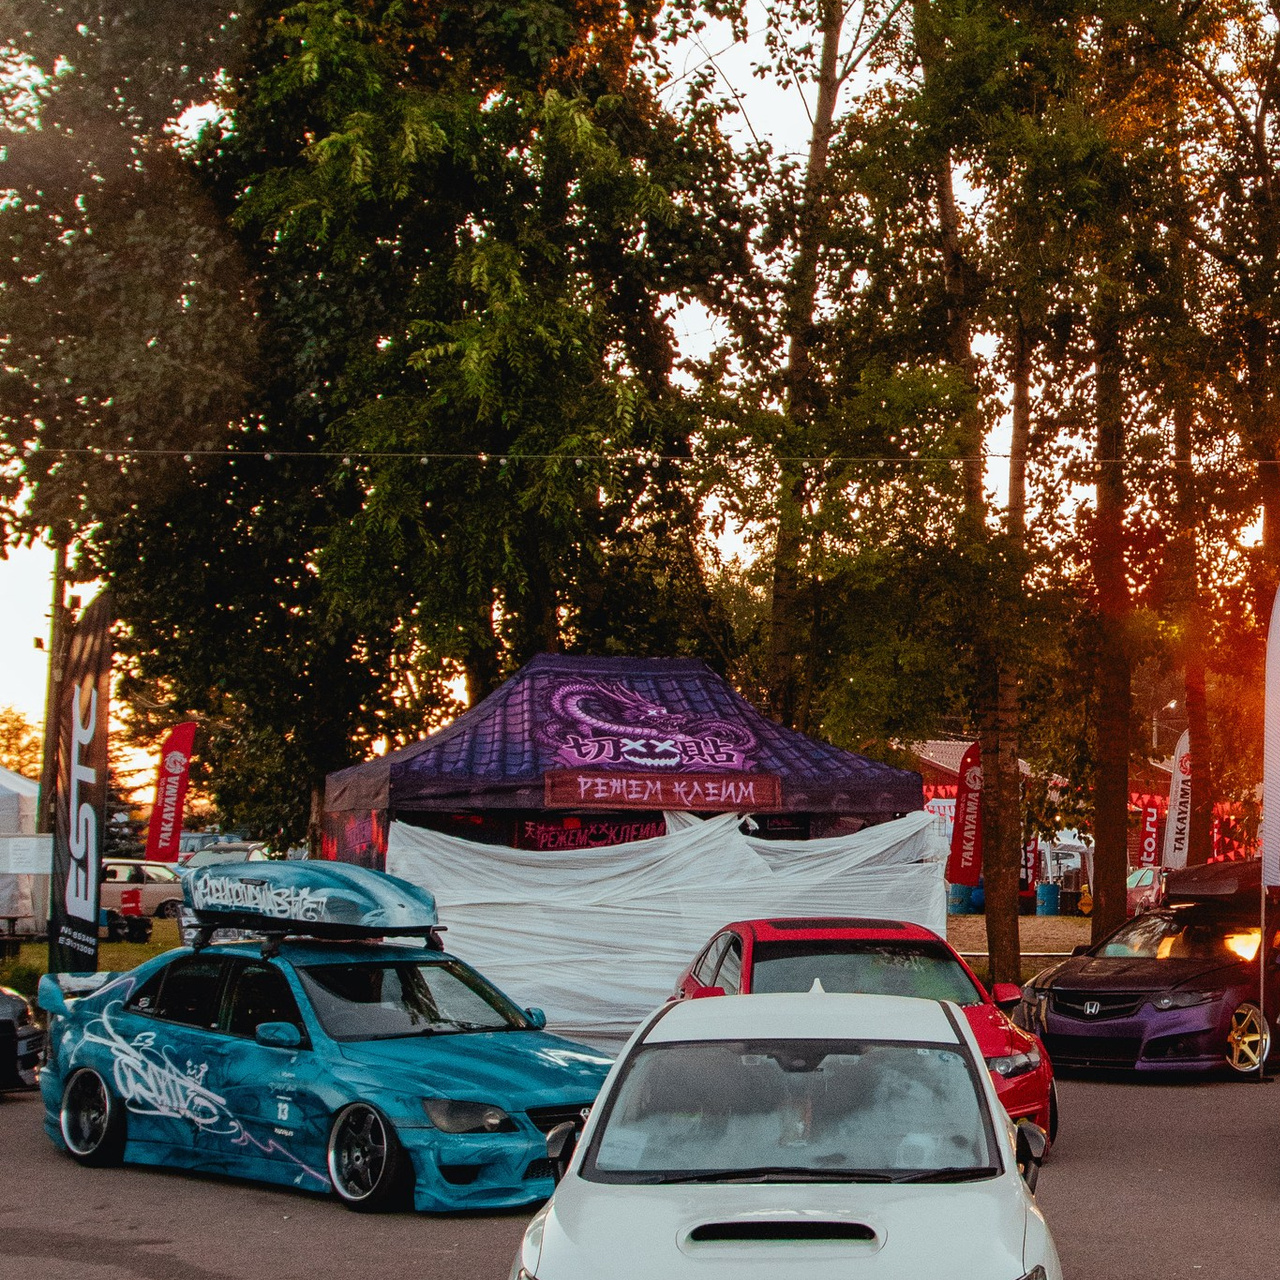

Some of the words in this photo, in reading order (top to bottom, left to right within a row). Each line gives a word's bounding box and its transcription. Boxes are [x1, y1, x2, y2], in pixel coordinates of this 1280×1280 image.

[65, 683, 97, 922] ESTC
[158, 775, 180, 849] TAKAYAMA
[576, 775, 663, 802] РЕЖЕМ
[672, 779, 756, 807] КЛЕИМ
[1173, 778, 1192, 853] TAKAYAMA
[961, 791, 980, 868] TAKAYAMA
